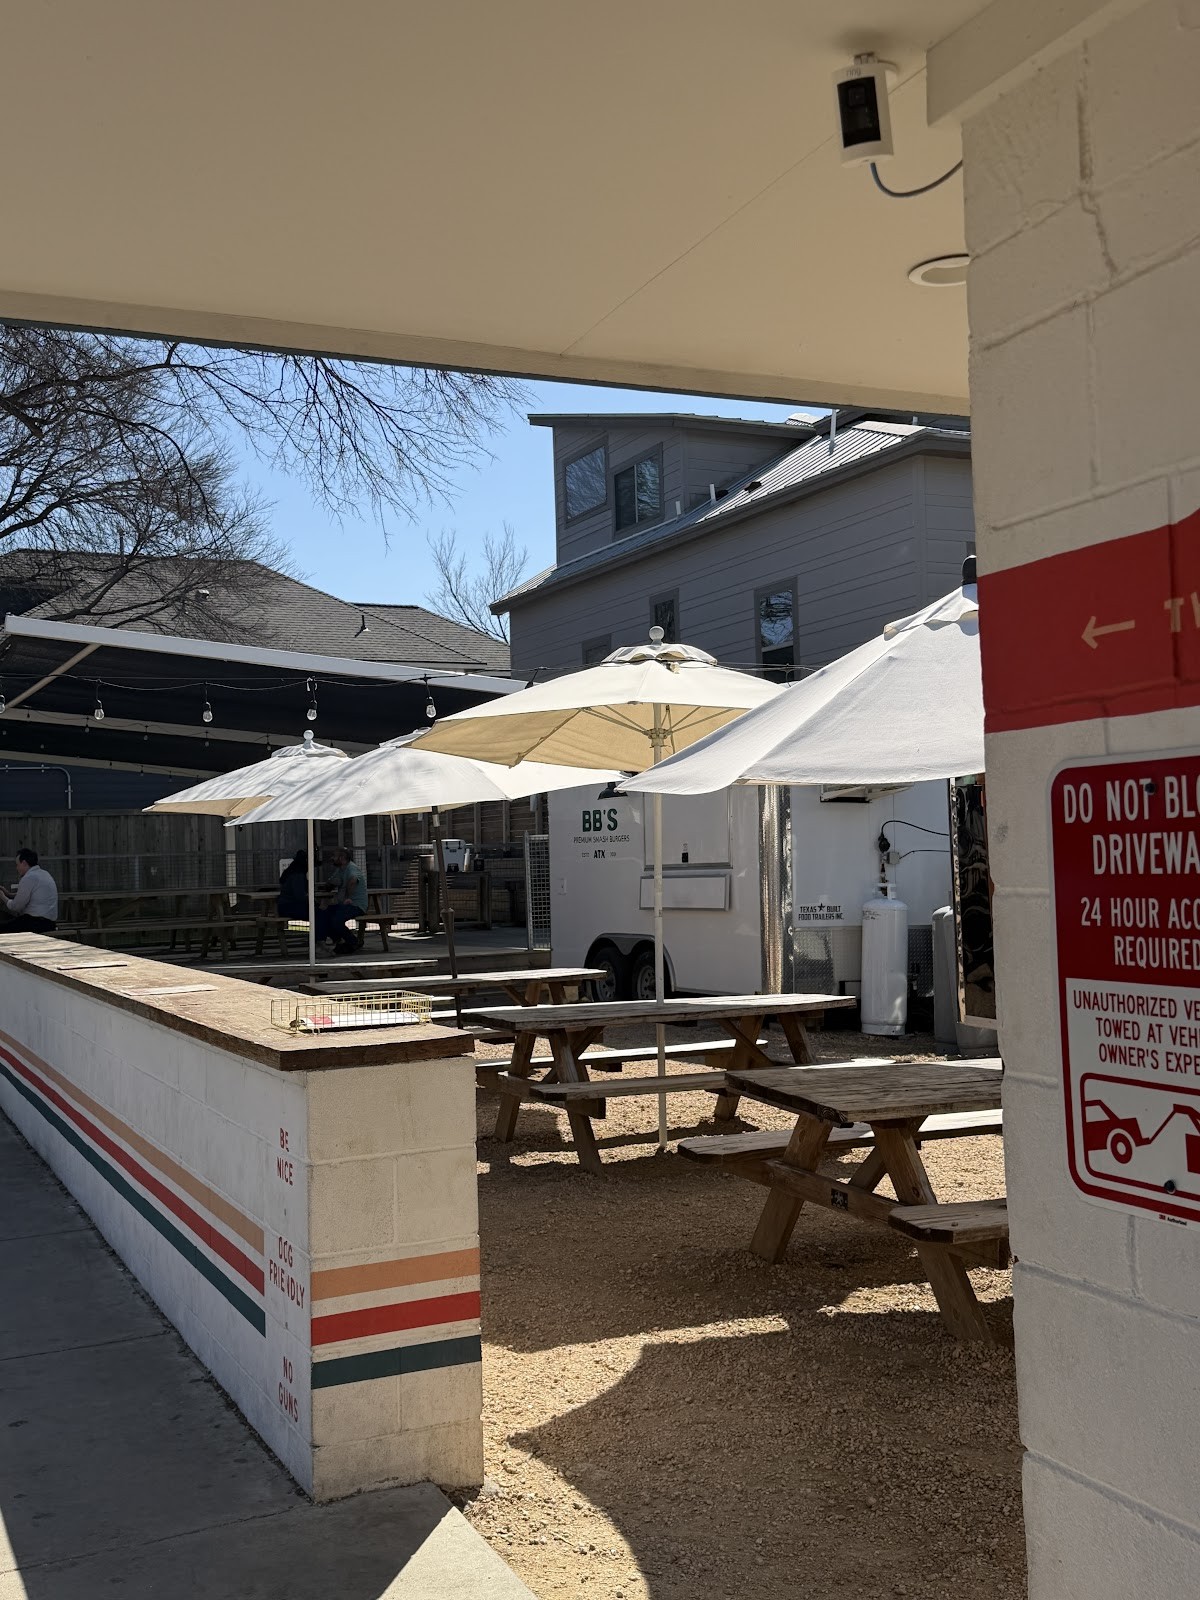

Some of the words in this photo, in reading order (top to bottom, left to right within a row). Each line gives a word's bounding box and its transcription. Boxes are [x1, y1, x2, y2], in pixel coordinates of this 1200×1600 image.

[1063, 782, 1093, 824] DO
[1106, 777, 1152, 821] NOT
[582, 808, 618, 832] BB'S
[593, 835, 609, 843] SMASH
[609, 834, 630, 842] BURGERS
[593, 849, 605, 858] ATX
[1092, 831, 1200, 875] DRIVEWA
[1080, 897, 1101, 926] 24
[1110, 897, 1160, 929] HOUR
[1114, 935, 1200, 971] REQUIRED
[1073, 990, 1177, 1019] UNAUTHORIZED
[1096, 1017, 1141, 1042] TOWED
[1147, 1023, 1164, 1044] AT
[1099, 1042, 1159, 1070] OWNER'S
[1165, 1051, 1200, 1076] EXPE
[280, 1127, 289, 1152] BE
[277, 1156, 293, 1186] NICE
[278, 1236, 293, 1268] DOG
[269, 1258, 304, 1309] FRIENDLY
[283, 1356, 293, 1384] NO
[278, 1381, 298, 1423] GUNS
